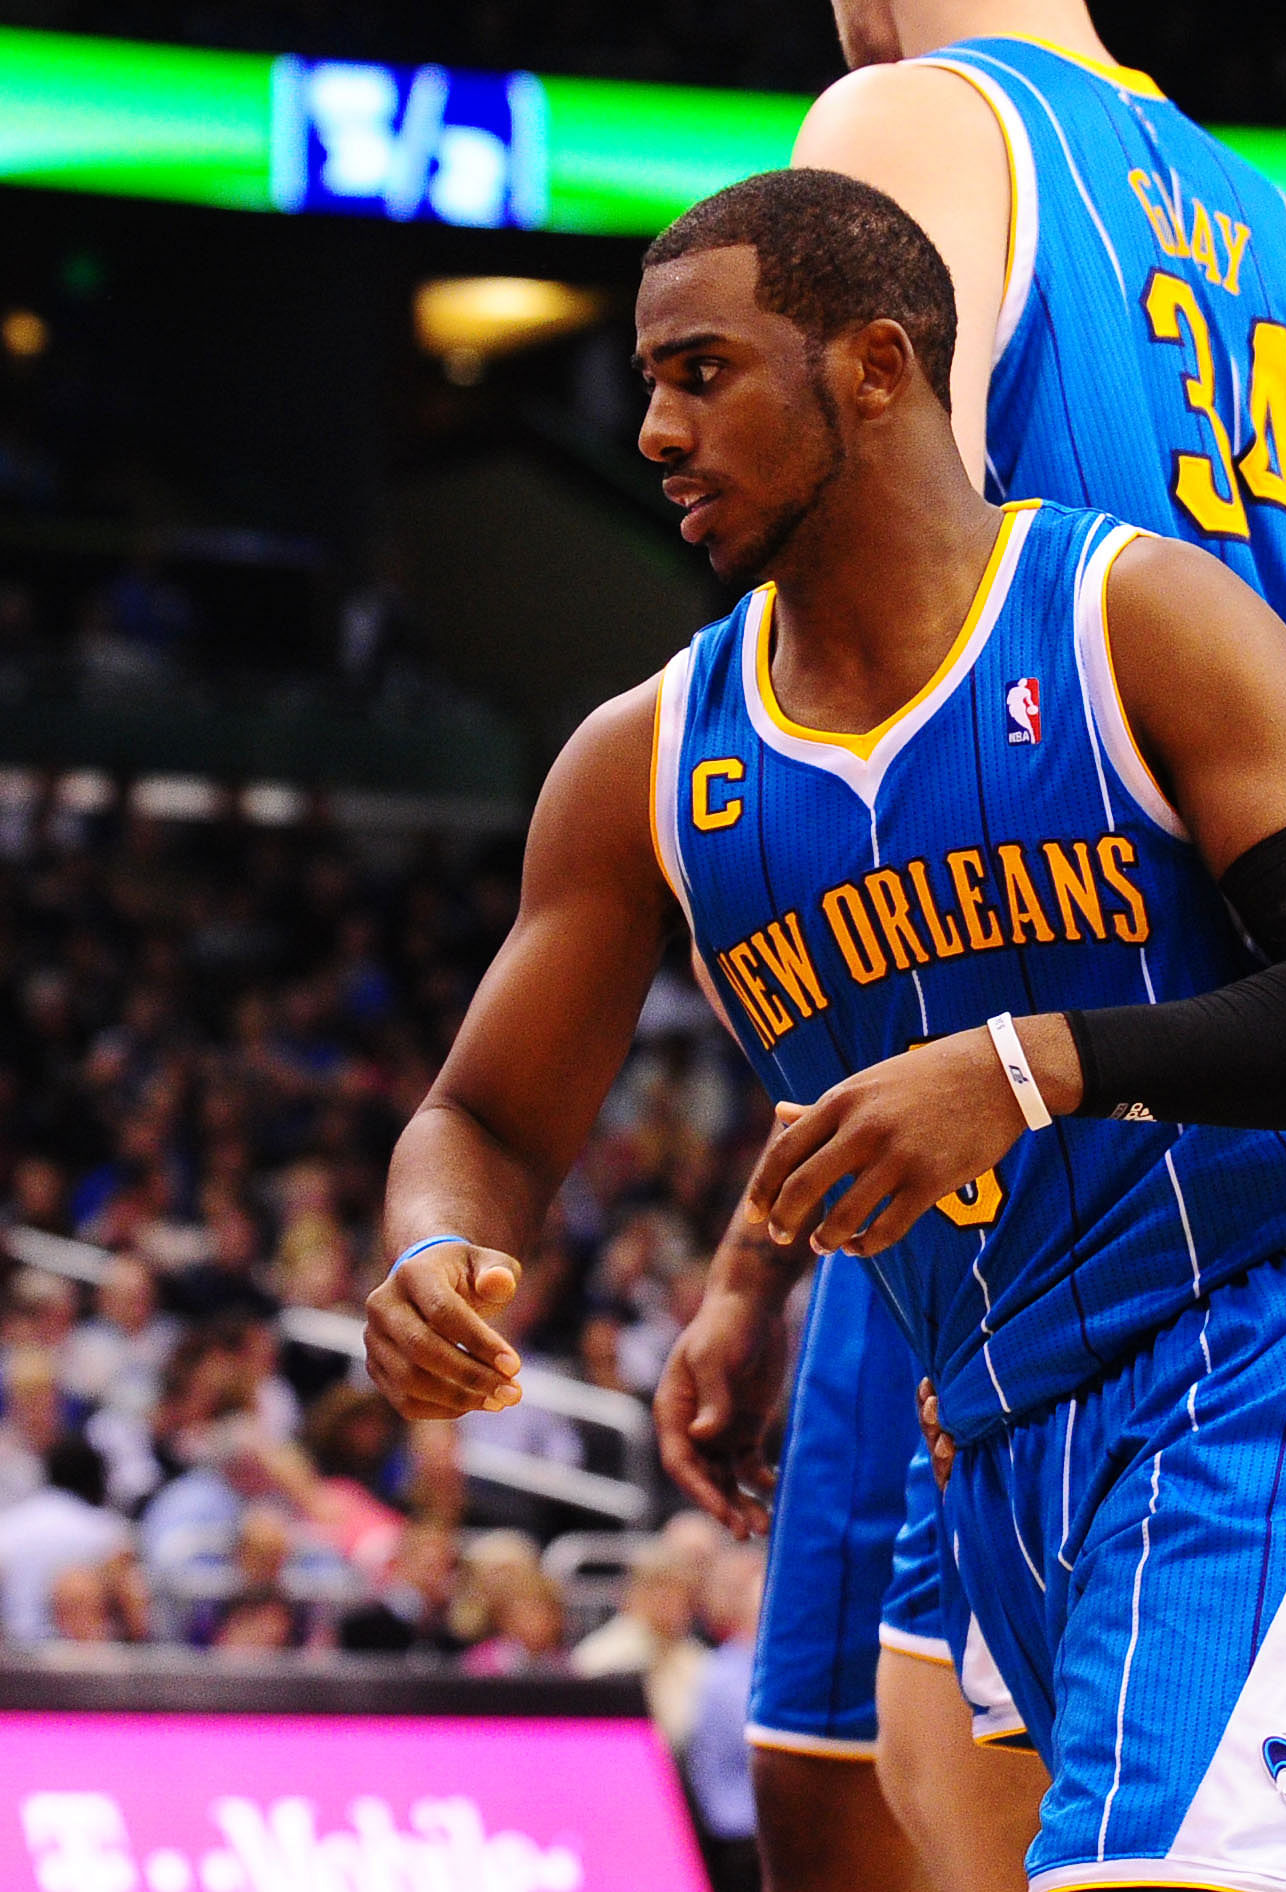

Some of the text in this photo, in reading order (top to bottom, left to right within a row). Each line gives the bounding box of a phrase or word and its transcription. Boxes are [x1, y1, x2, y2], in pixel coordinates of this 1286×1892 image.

[690, 756, 746, 833] C
[715, 835, 1152, 1052] NEW ORLEANS
